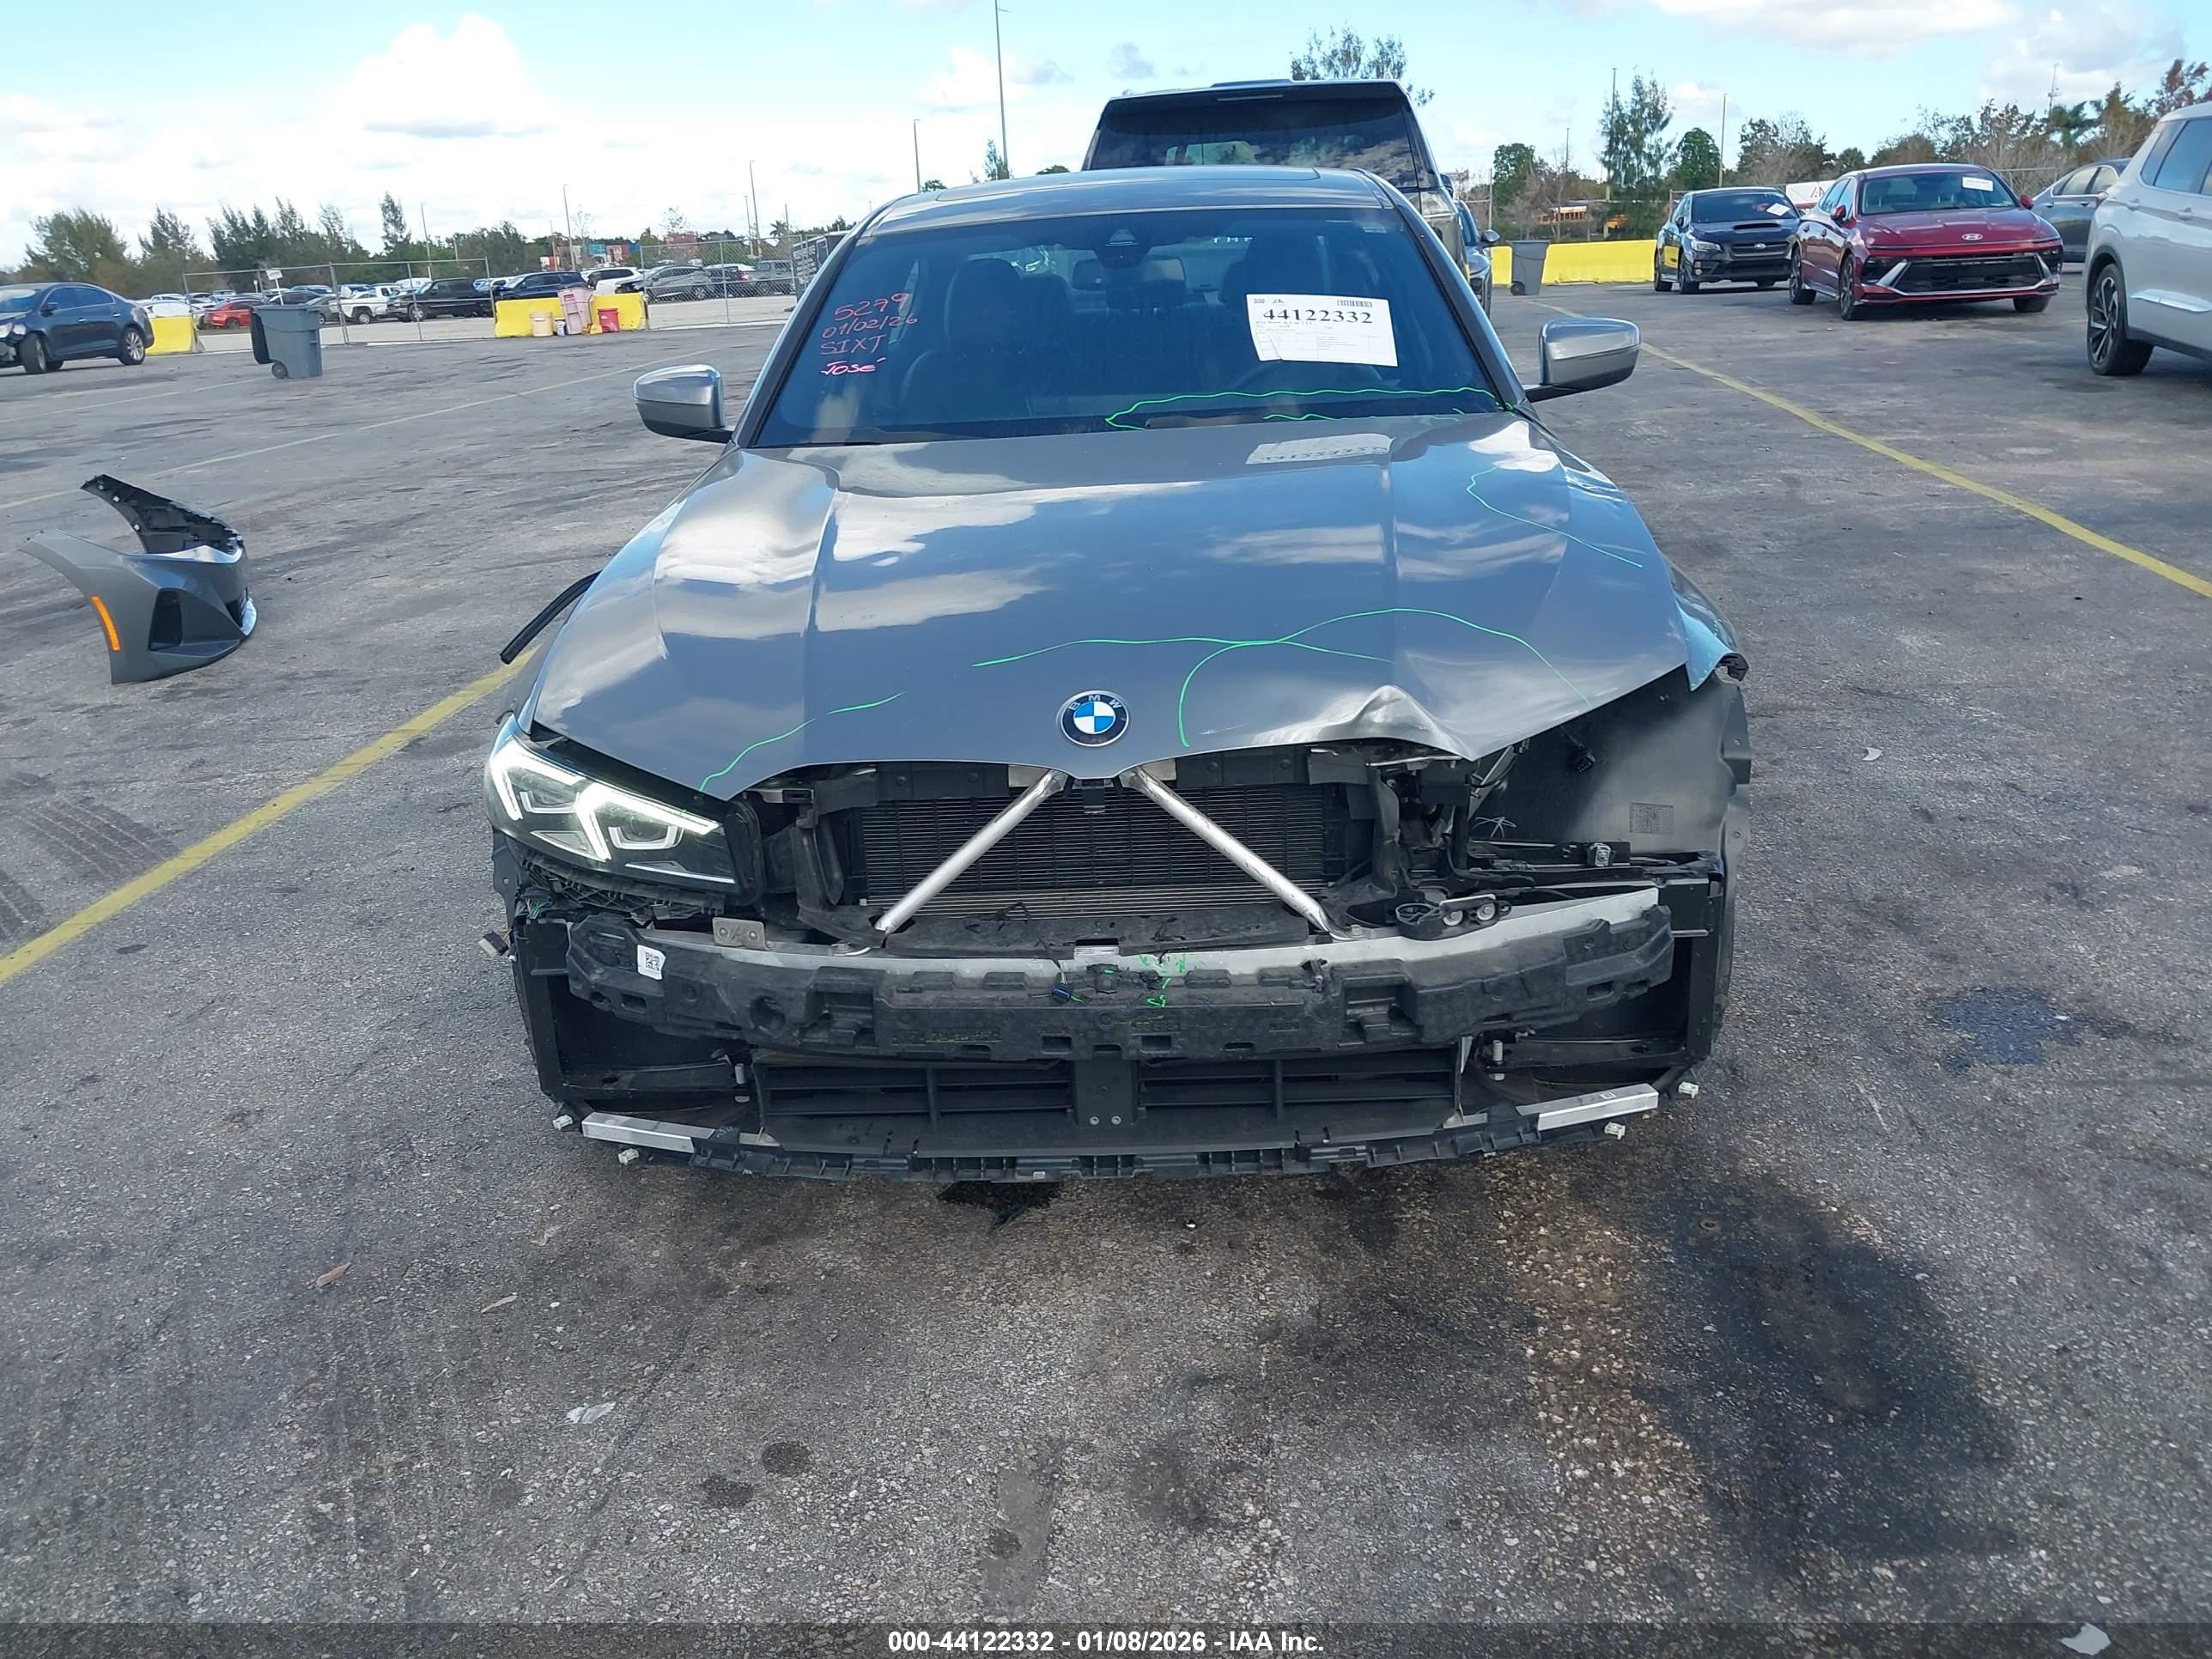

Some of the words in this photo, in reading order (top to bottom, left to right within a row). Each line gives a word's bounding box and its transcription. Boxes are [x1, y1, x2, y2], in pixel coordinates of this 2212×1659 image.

[834, 293, 910, 321] 5279
[1263, 309, 1372, 324] 44122332
[822, 313, 918, 338] 01/02/26
[820, 334, 886, 355] SIXT
